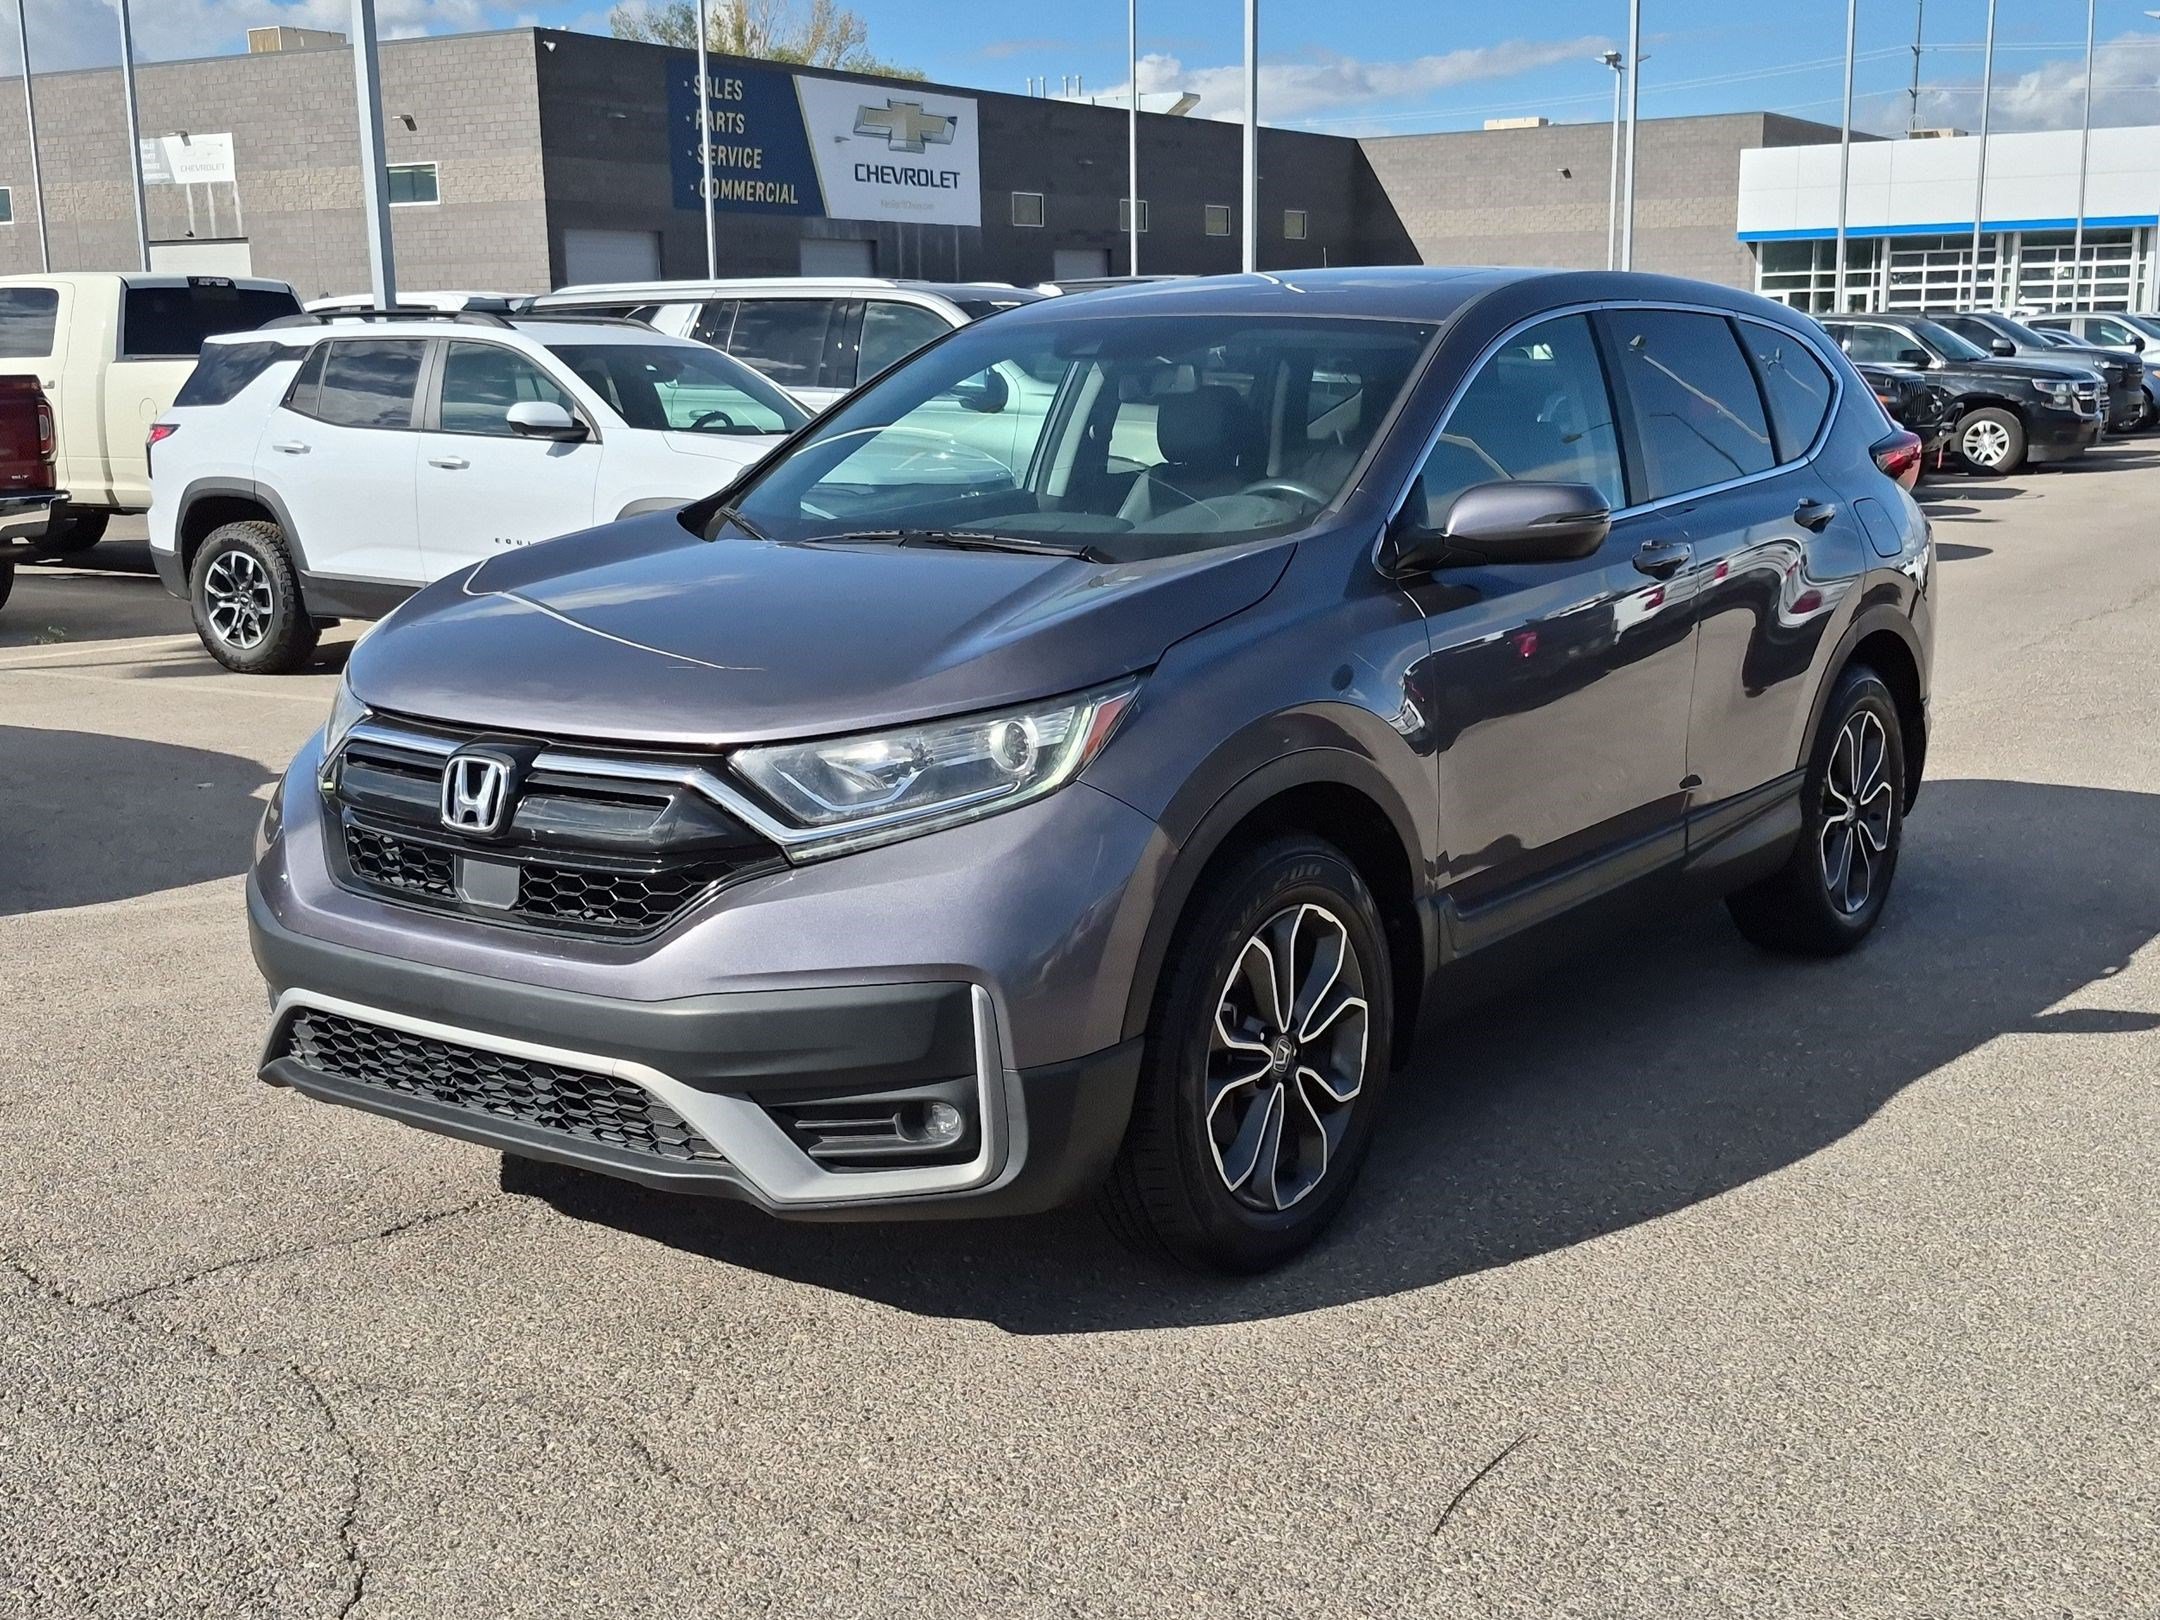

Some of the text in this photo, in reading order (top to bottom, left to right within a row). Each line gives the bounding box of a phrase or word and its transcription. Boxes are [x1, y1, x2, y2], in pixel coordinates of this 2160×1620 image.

[693, 74, 743, 101] SALES
[695, 108, 745, 134] PARTS
[697, 143, 762, 169] SERVICE
[854, 163, 960, 189] CHEVROLET
[699, 177, 799, 204] COMMERCIAL
